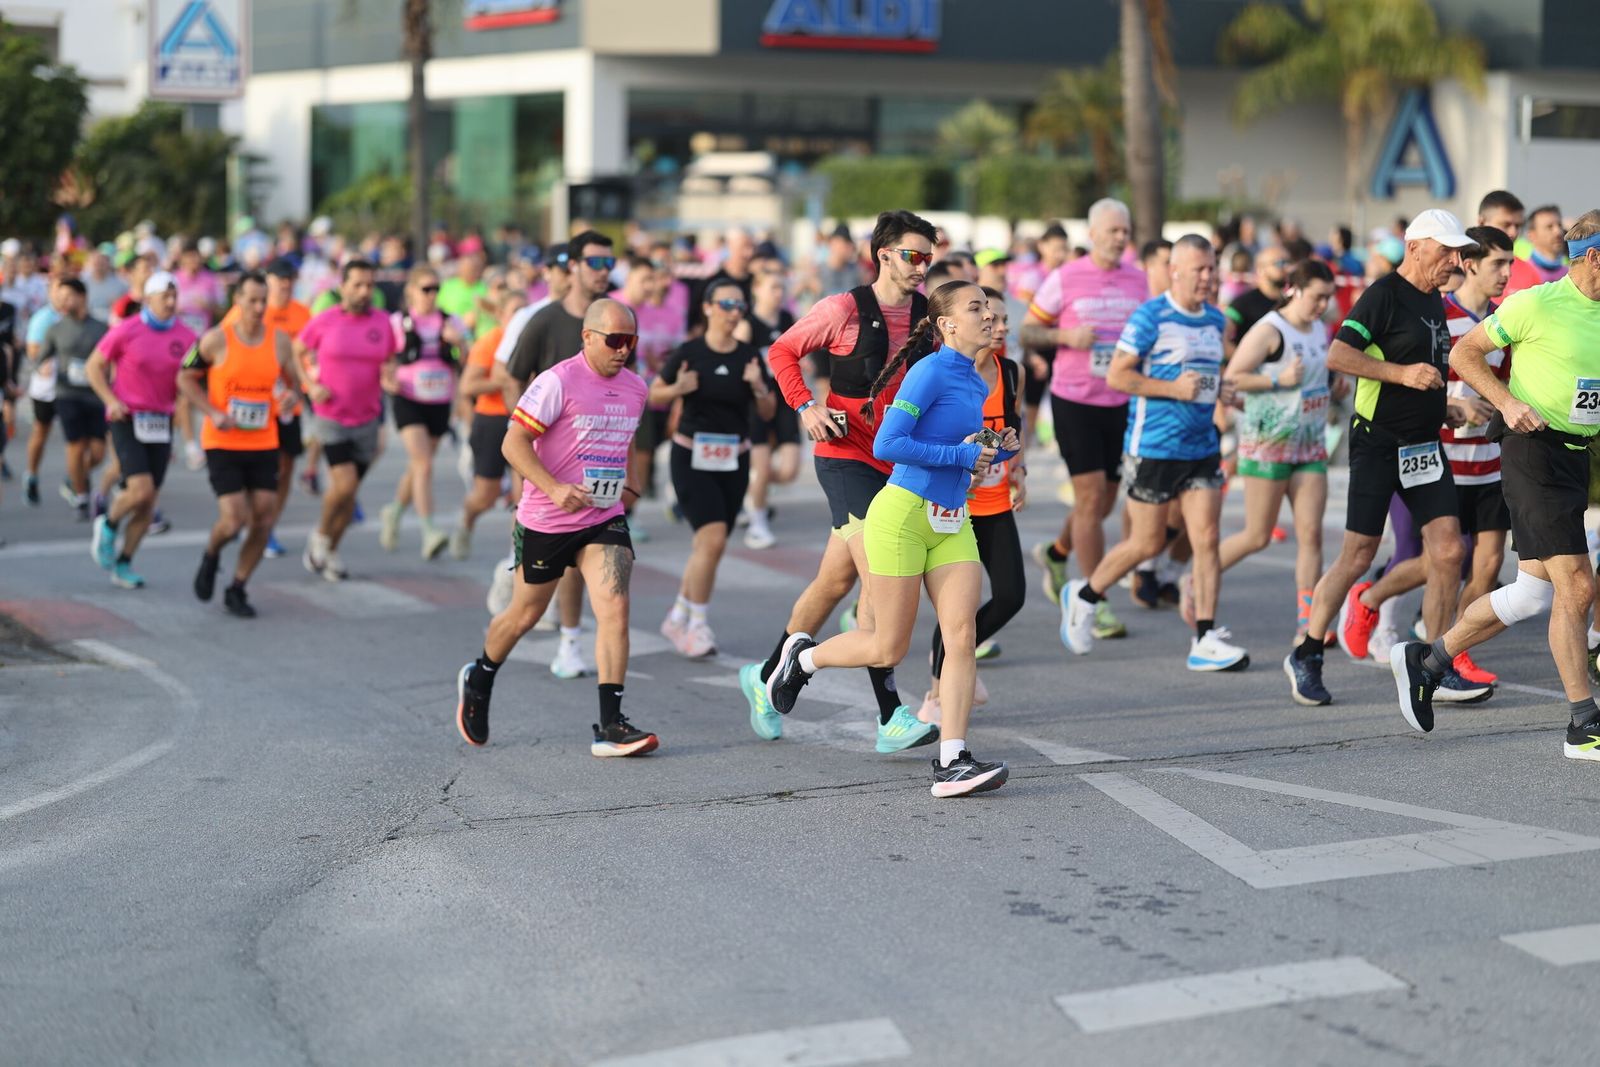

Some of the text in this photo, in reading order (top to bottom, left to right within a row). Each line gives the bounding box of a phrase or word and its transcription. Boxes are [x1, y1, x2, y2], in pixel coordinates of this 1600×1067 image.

[1576, 391, 1600, 410] 23
[1401, 453, 1439, 475] 2354
[592, 480, 619, 496] 111
